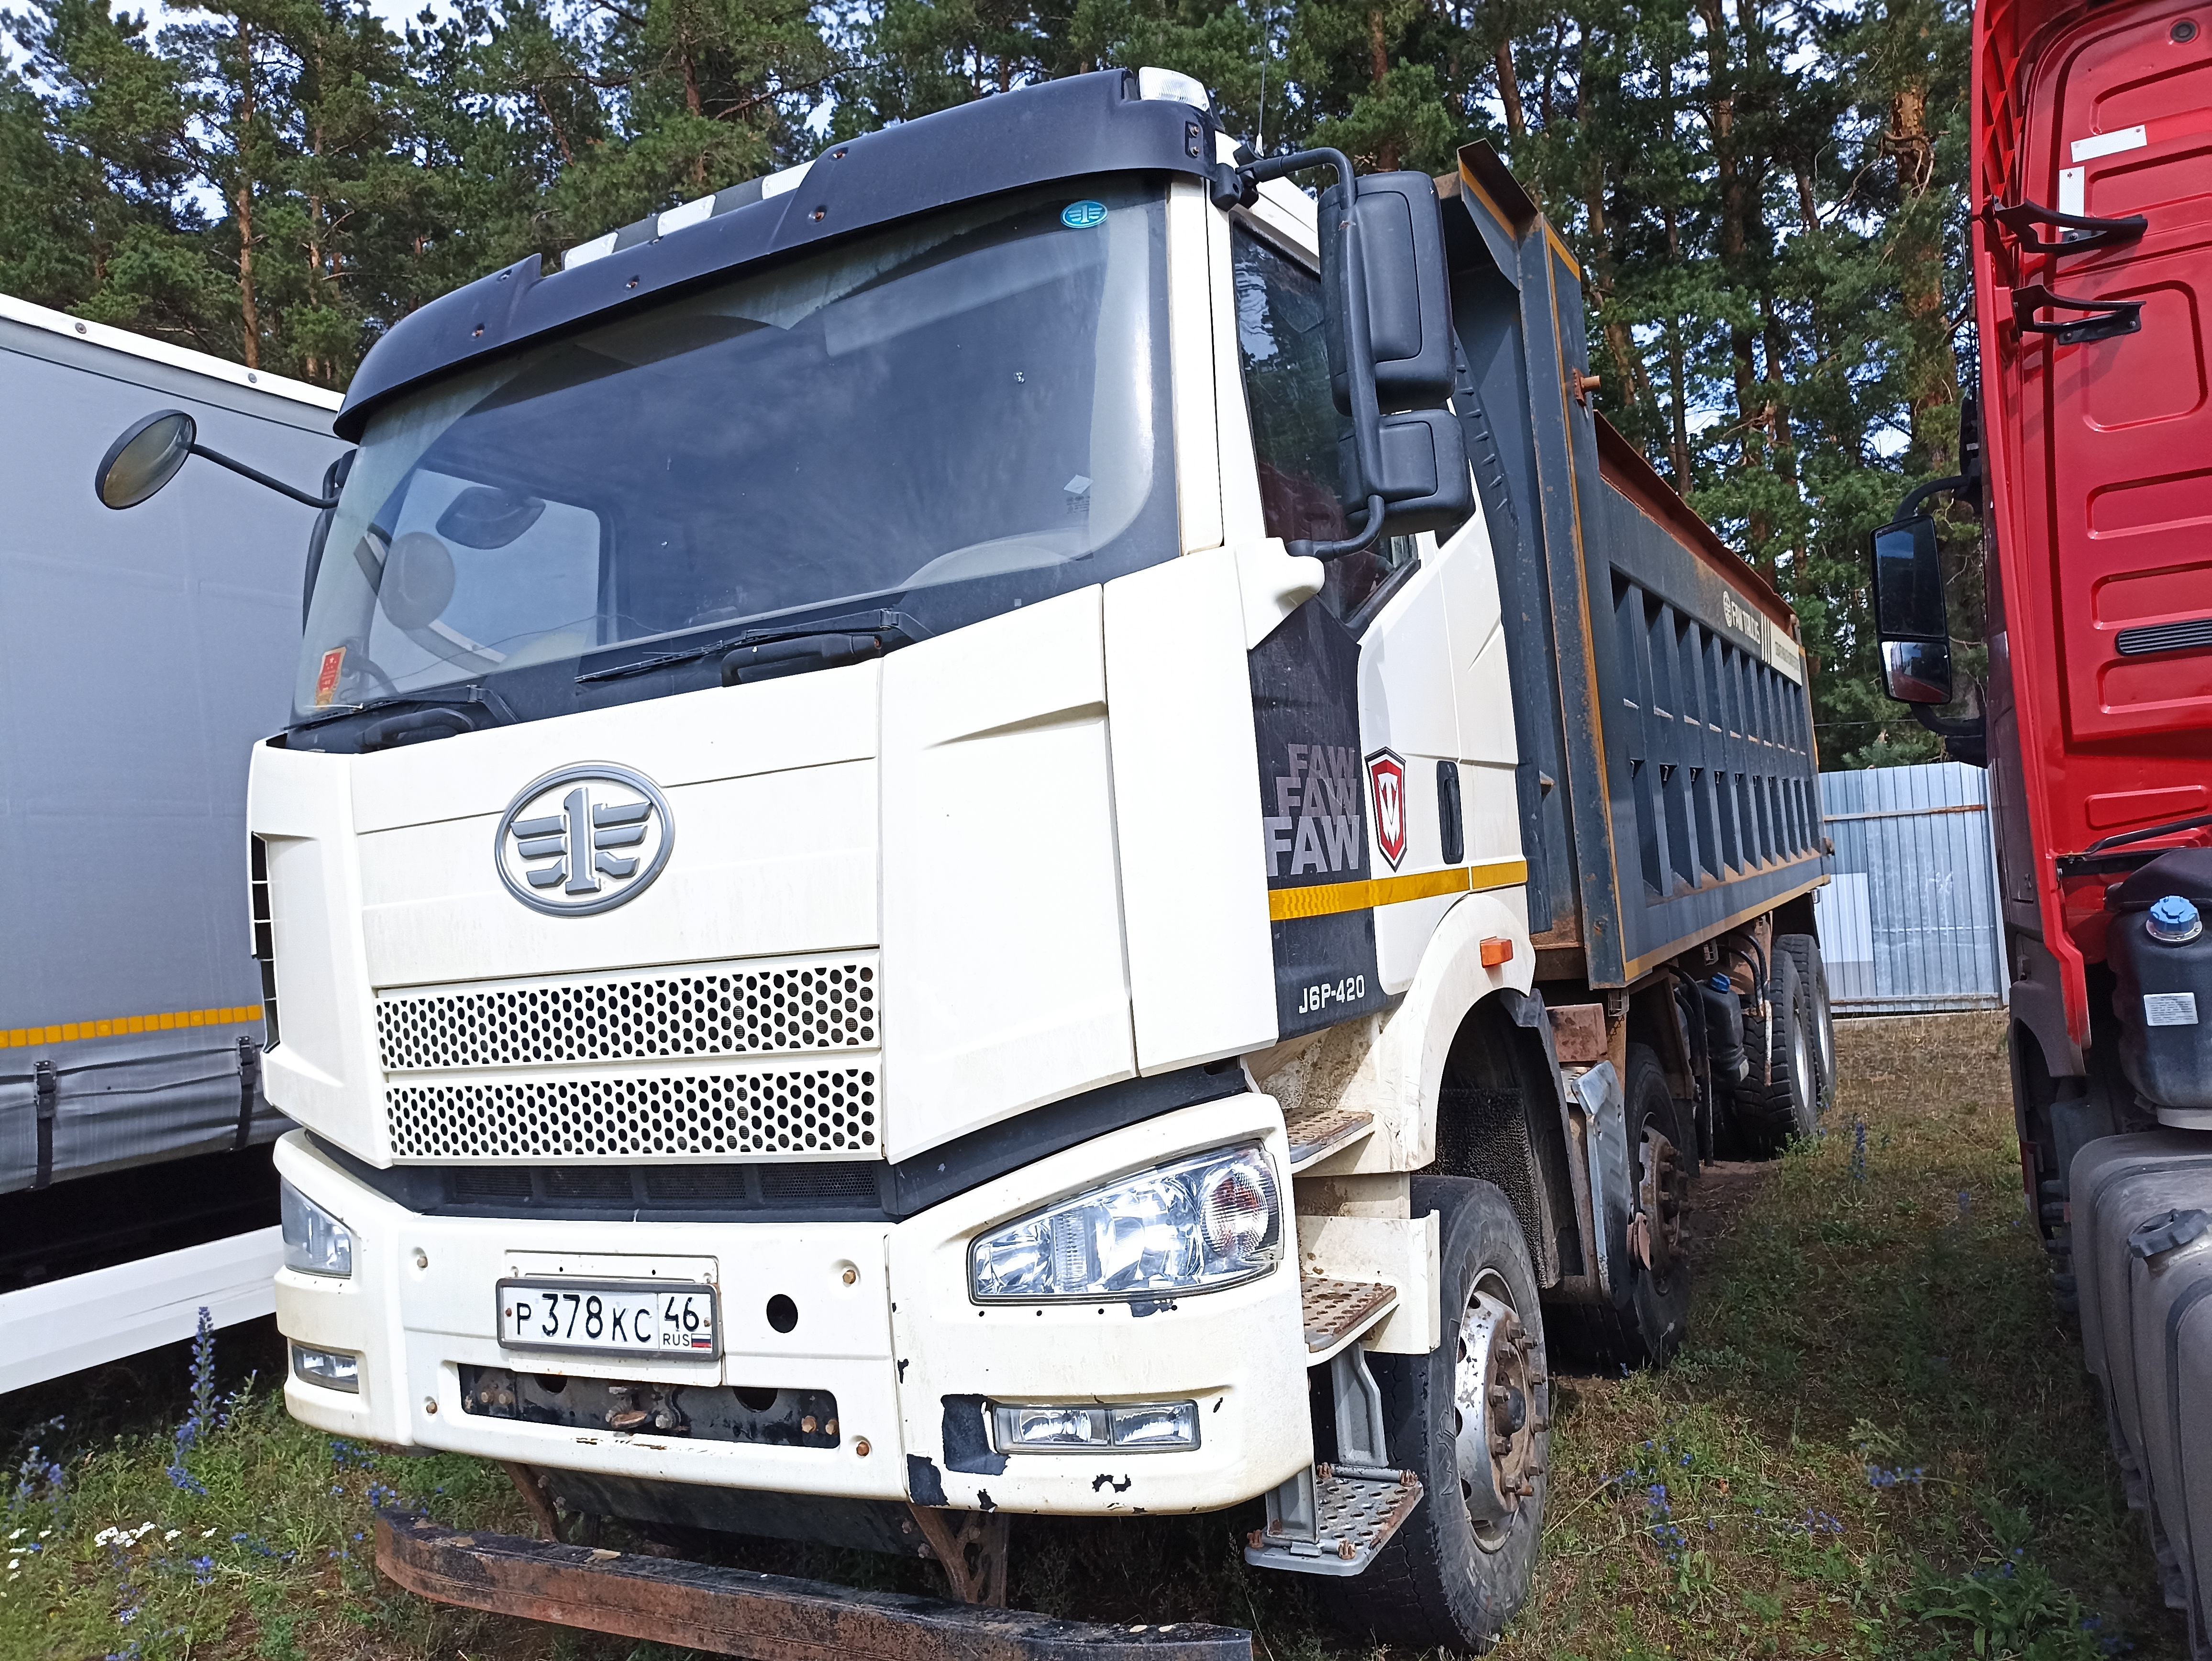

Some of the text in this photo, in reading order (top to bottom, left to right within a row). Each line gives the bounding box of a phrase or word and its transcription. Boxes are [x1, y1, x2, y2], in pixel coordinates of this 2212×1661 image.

[1288, 743, 1355, 780] FAW
[1276, 776, 1358, 824] FAW
[1263, 815, 1360, 876] FAW
[1299, 974, 1365, 1014] J6P-420
[664, 1296, 699, 1332] 46
[663, 1333, 690, 1347] RUS
